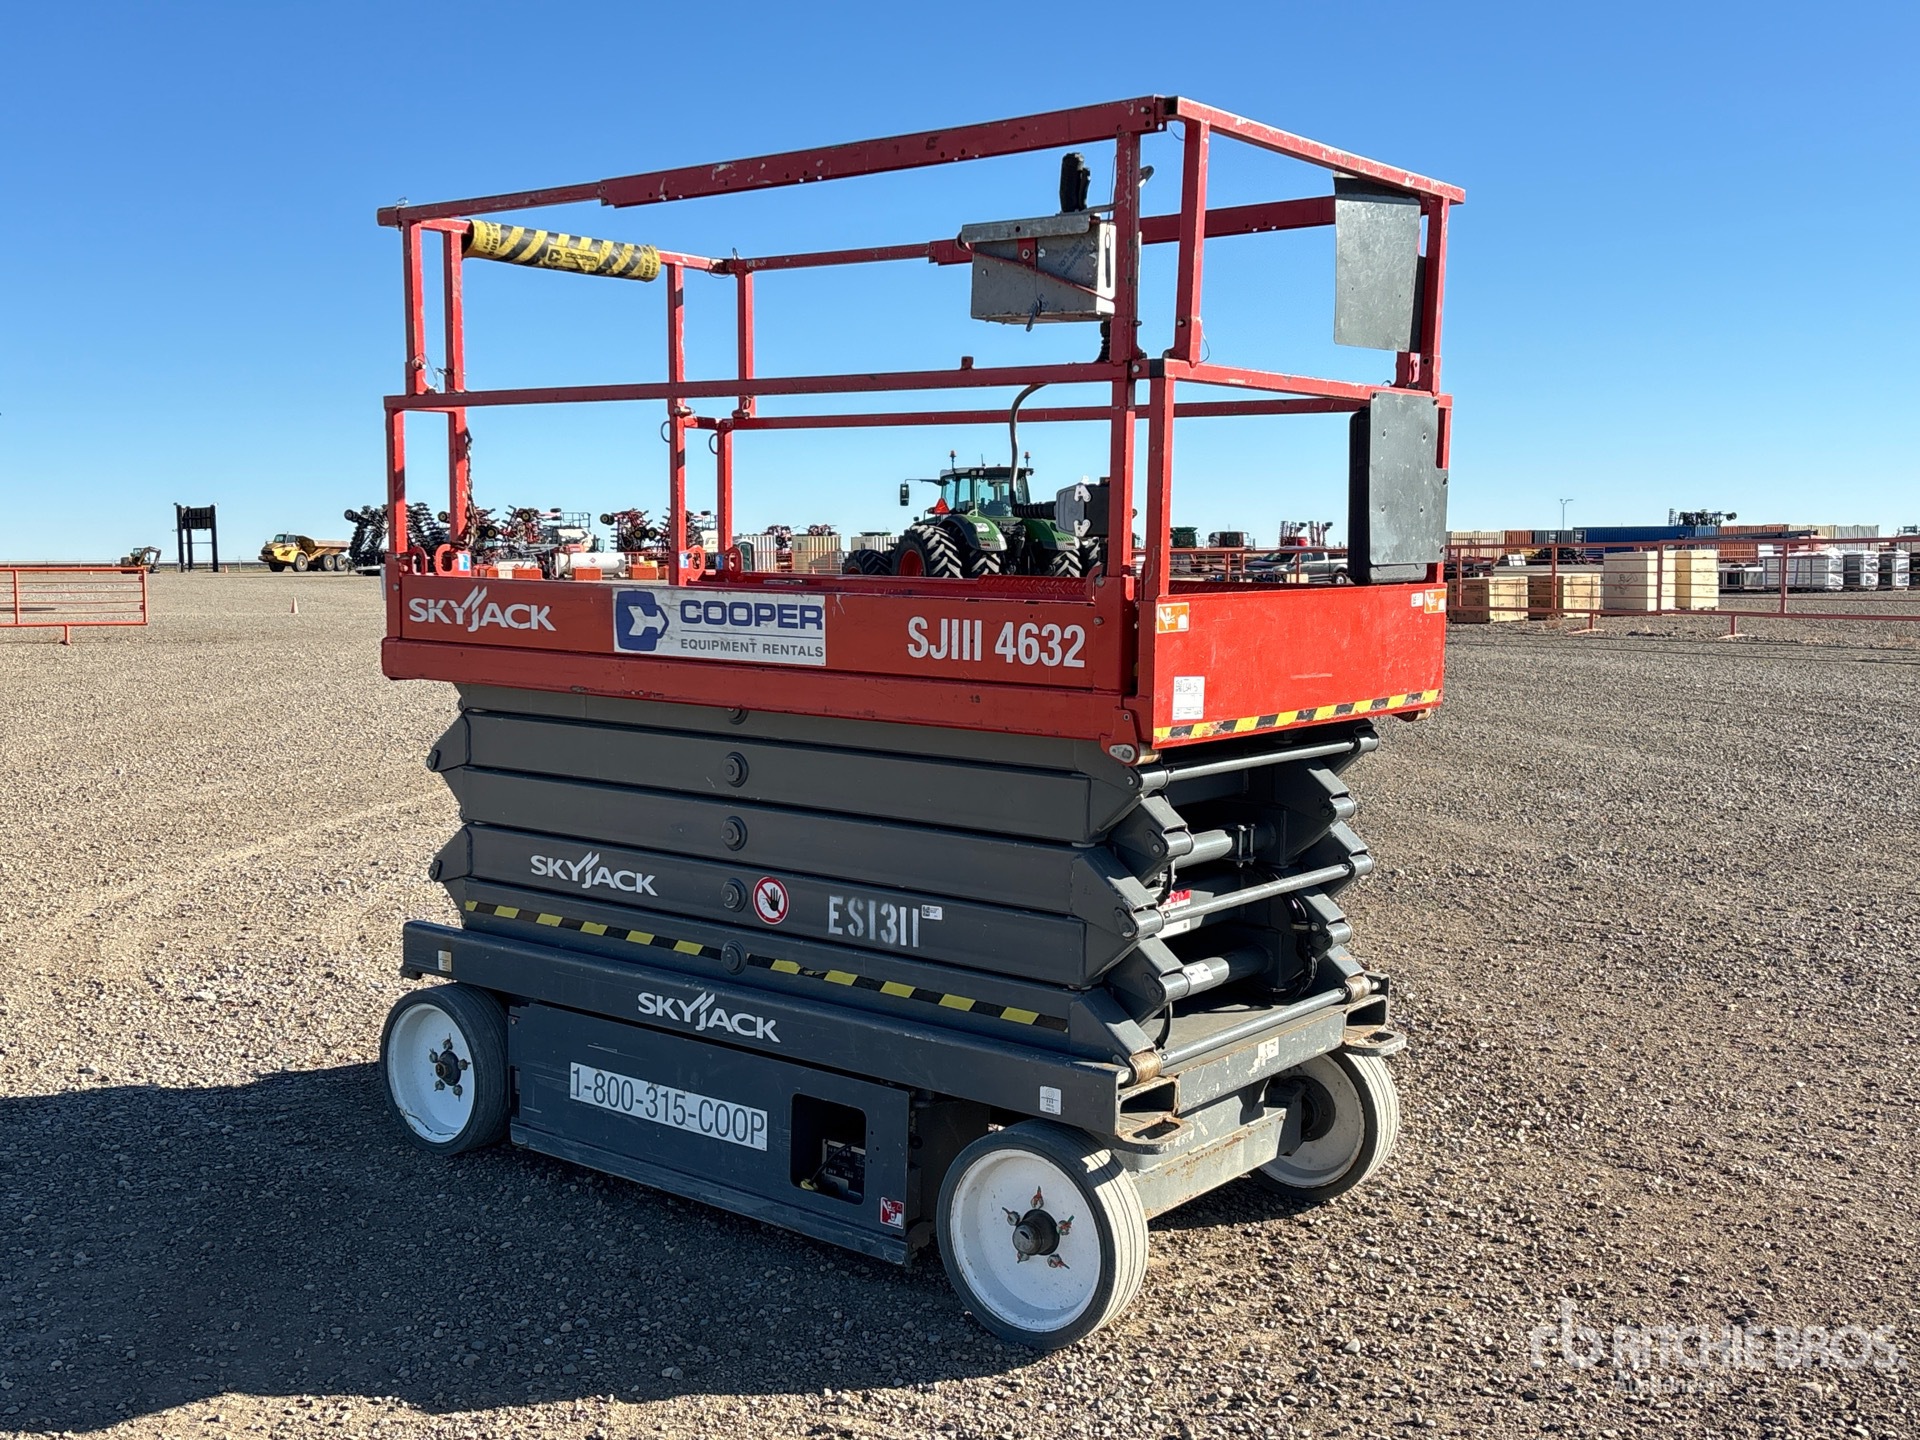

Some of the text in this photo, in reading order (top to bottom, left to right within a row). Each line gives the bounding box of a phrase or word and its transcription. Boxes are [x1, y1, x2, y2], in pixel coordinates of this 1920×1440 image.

[409, 585, 556, 632] SKYJACK
[680, 600, 823, 631] COOPER
[680, 638, 824, 658] EQUIPMENT RENTALS
[994, 622, 1085, 668] 4632
[530, 851, 659, 897] SKYJACK
[637, 991, 782, 1044] SKYJACK
[571, 1066, 766, 1146] 1-800-315-COOP
